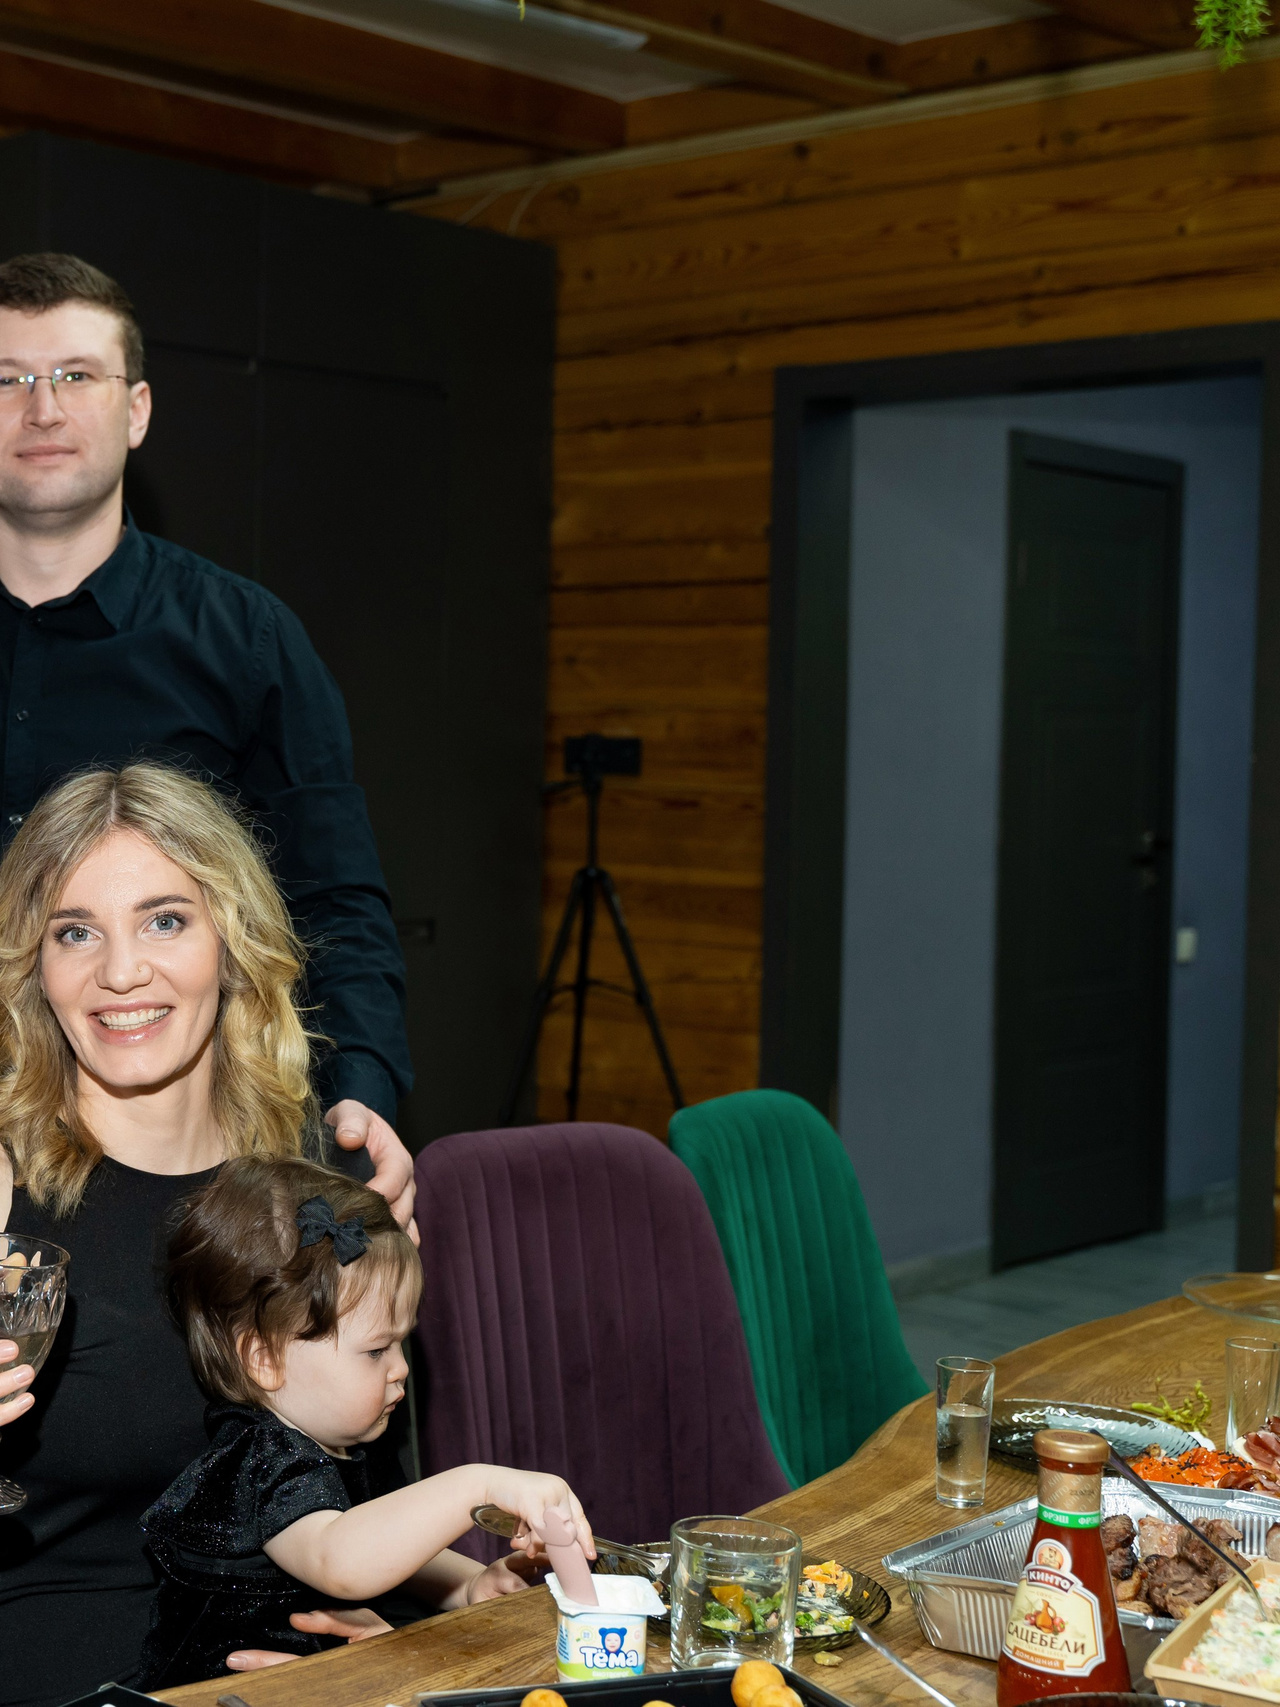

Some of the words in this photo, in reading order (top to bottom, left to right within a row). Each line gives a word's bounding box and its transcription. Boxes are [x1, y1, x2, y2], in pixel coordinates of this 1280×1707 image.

[1042, 1510, 1069, 1524] ФРЭШ
[1029, 1570, 1071, 1590] КИНТО
[1007, 1621, 1086, 1655] САЦЕБЕЛИ
[579, 1646, 639, 1669] Тёма
[1014, 1650, 1060, 1668] ДОМАШНИЙ
